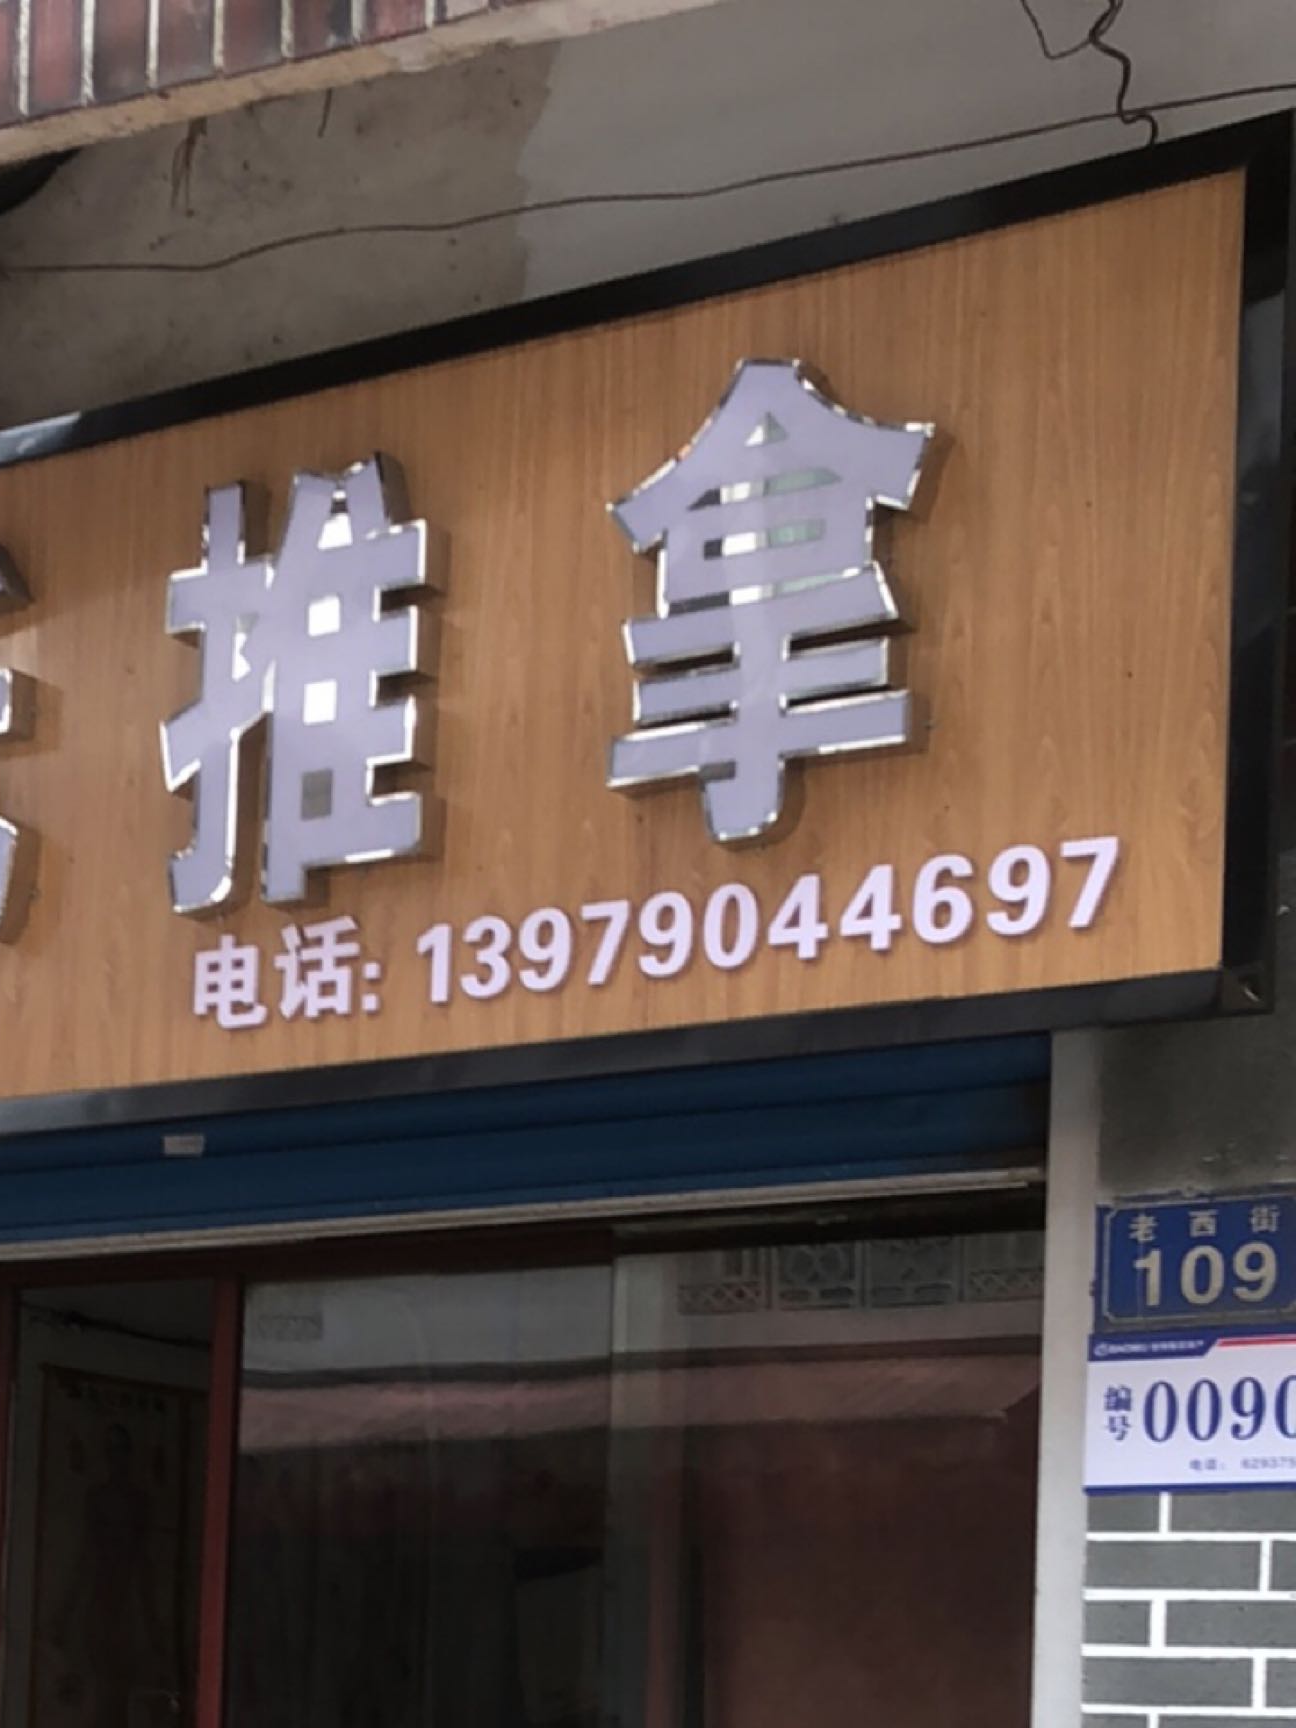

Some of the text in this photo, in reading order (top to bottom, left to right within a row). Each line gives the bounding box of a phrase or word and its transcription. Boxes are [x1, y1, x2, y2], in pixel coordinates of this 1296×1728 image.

[191, 836, 1120, 1030] 电话: 13979044697
[1129, 1204, 1279, 1242] 老西街
[1133, 1241, 1278, 1306] 109
[1102, 1385, 1133, 1441] 编号
[1142, 1374, 1296, 1443] 0090
